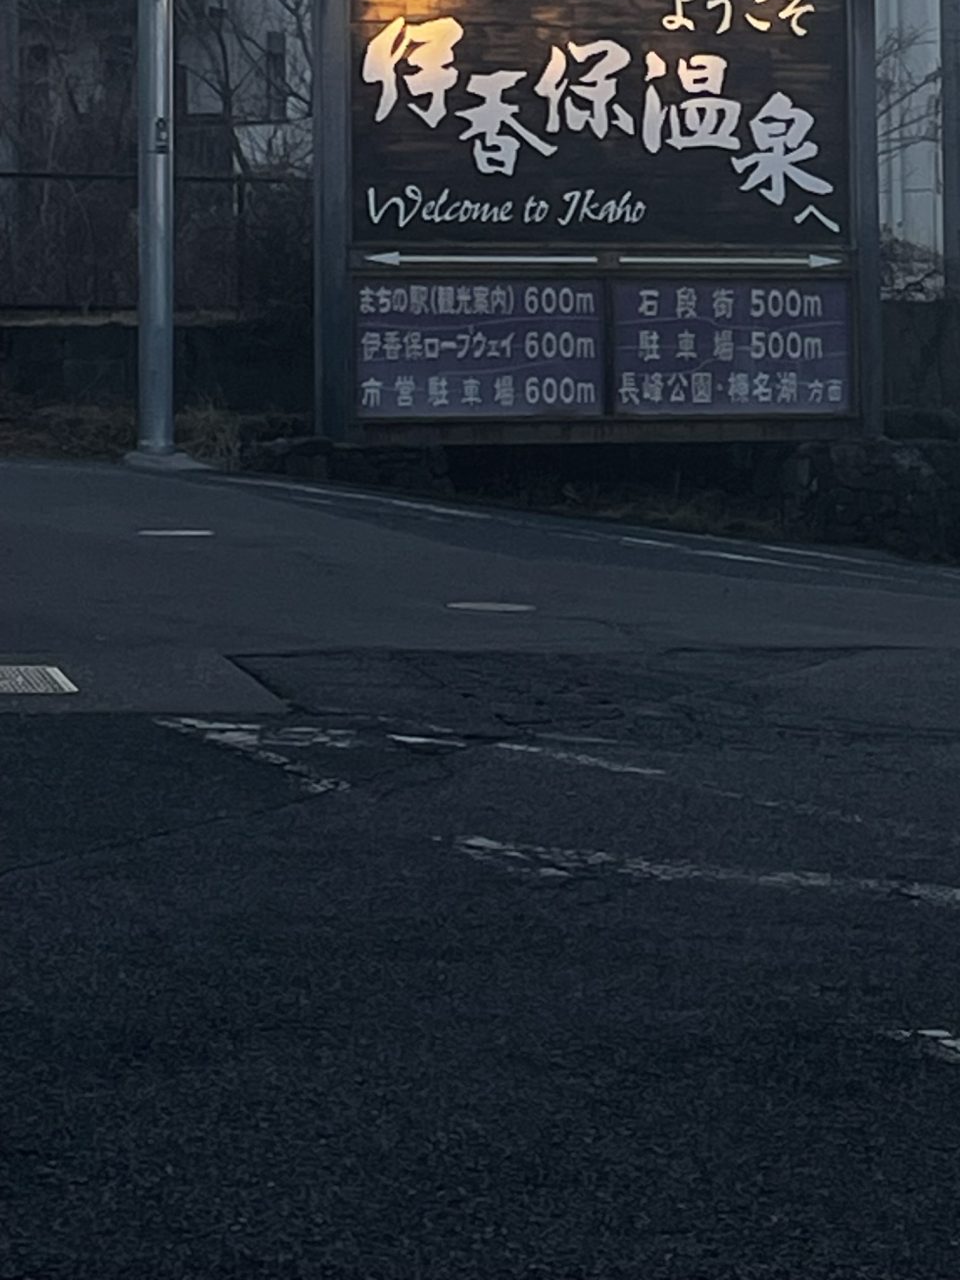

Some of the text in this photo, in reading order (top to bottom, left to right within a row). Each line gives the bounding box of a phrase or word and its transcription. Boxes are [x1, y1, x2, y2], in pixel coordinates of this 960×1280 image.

[366, 185, 646, 228] Welcome to Ikaho
[359, 285, 595, 315] まちの駅(観光案内) 600m
[749, 289, 823, 318] 500m
[360, 326, 595, 361] 伊香保ロープウェイ 600m
[749, 331, 823, 359] 500m
[524, 376, 595, 404] 600m
